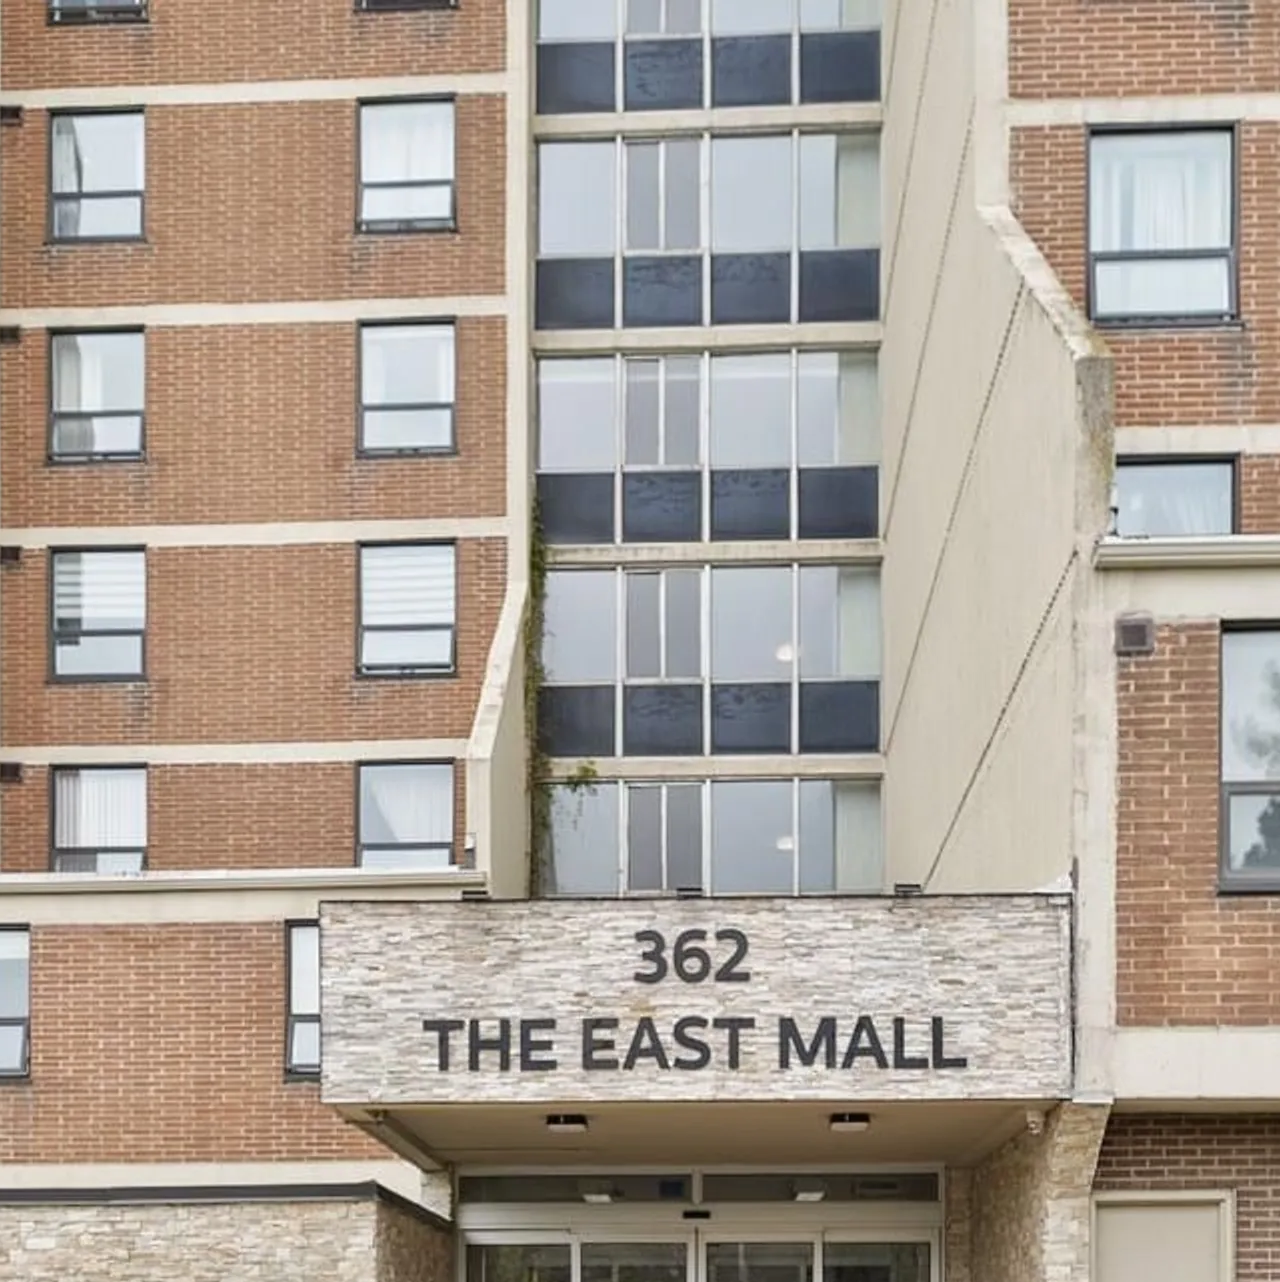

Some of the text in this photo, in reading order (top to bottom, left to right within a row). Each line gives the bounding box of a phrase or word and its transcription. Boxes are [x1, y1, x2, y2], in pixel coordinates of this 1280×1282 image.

[633, 928, 751, 984] 362
[422, 1015, 968, 1071] THE EAST MALL
